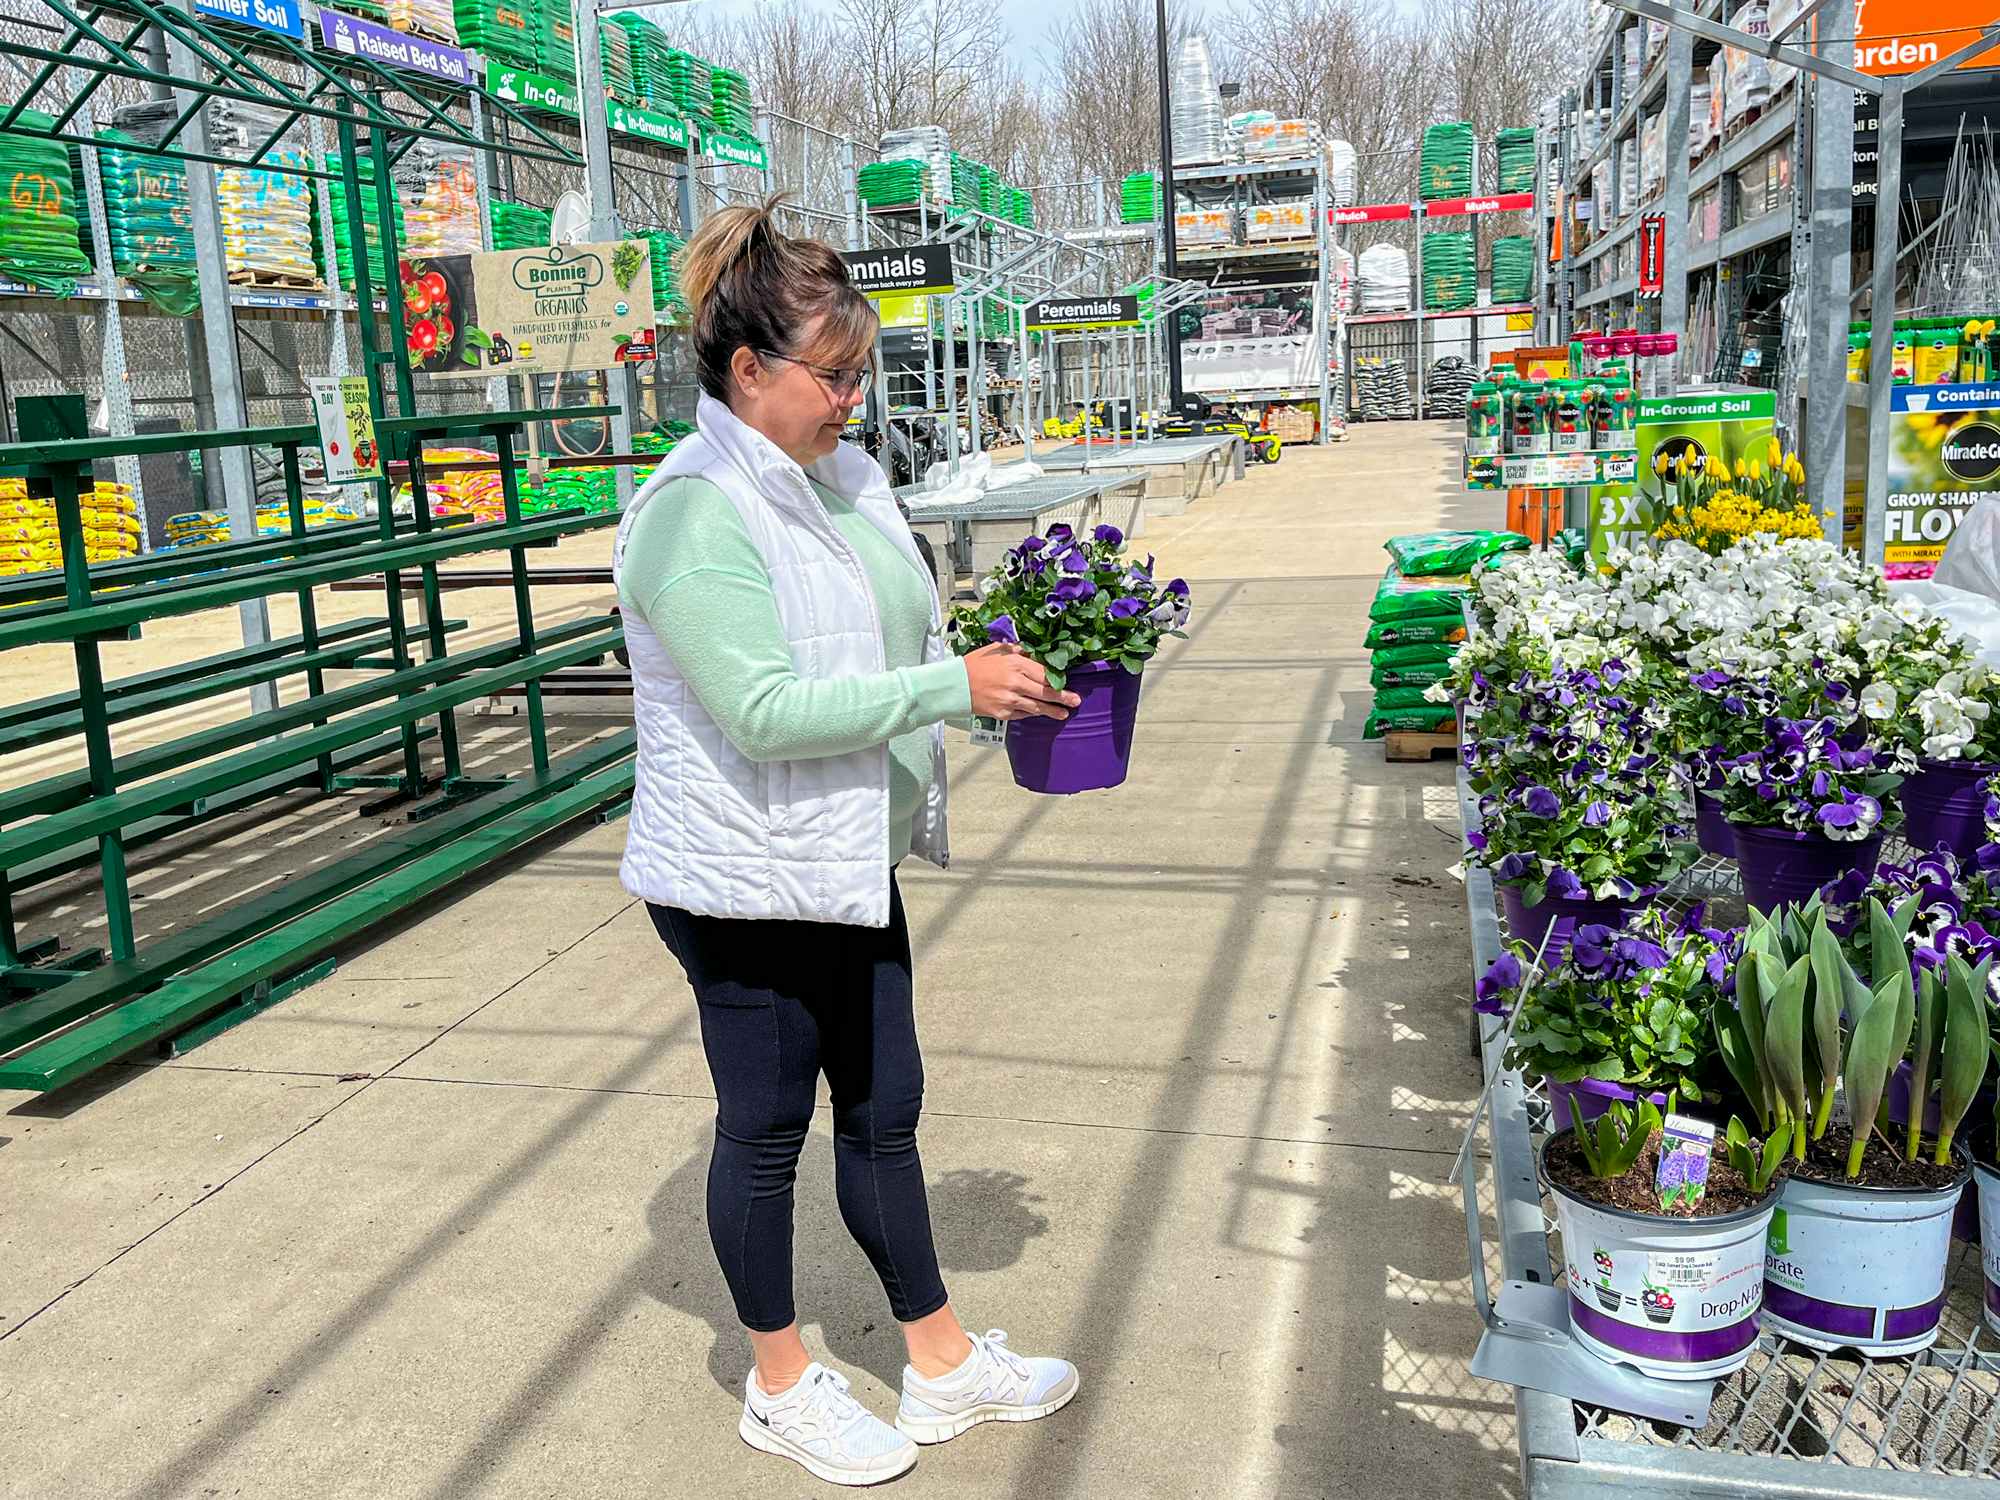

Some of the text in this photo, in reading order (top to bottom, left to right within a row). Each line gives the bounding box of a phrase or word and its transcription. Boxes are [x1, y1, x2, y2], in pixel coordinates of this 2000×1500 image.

[196, 0, 289, 29] iner Soil
[356, 30, 465, 78] Raised Bed Soil
[627, 113, 683, 144] In-Ground Soil
[1464, 200, 1500, 211] Mulch
[1335, 211, 1368, 222] Mulch
[1063, 227, 1146, 240] General Purpose
[529, 265, 586, 283] Bonnie
[895, 280, 912, 288] every
[535, 298, 588, 317] ORGANICS
[1039, 301, 1122, 318] Perennials
[513, 318, 612, 335] HANDPICKED FRESHNESS for
[536, 333, 590, 345] EVERYDAY MEALS
[1936, 388, 2000, 402] Contain
[1641, 399, 1750, 417] In-Ground Soil
[1888, 493, 1936, 507] GROW
[1600, 496, 1642, 526] 3X
